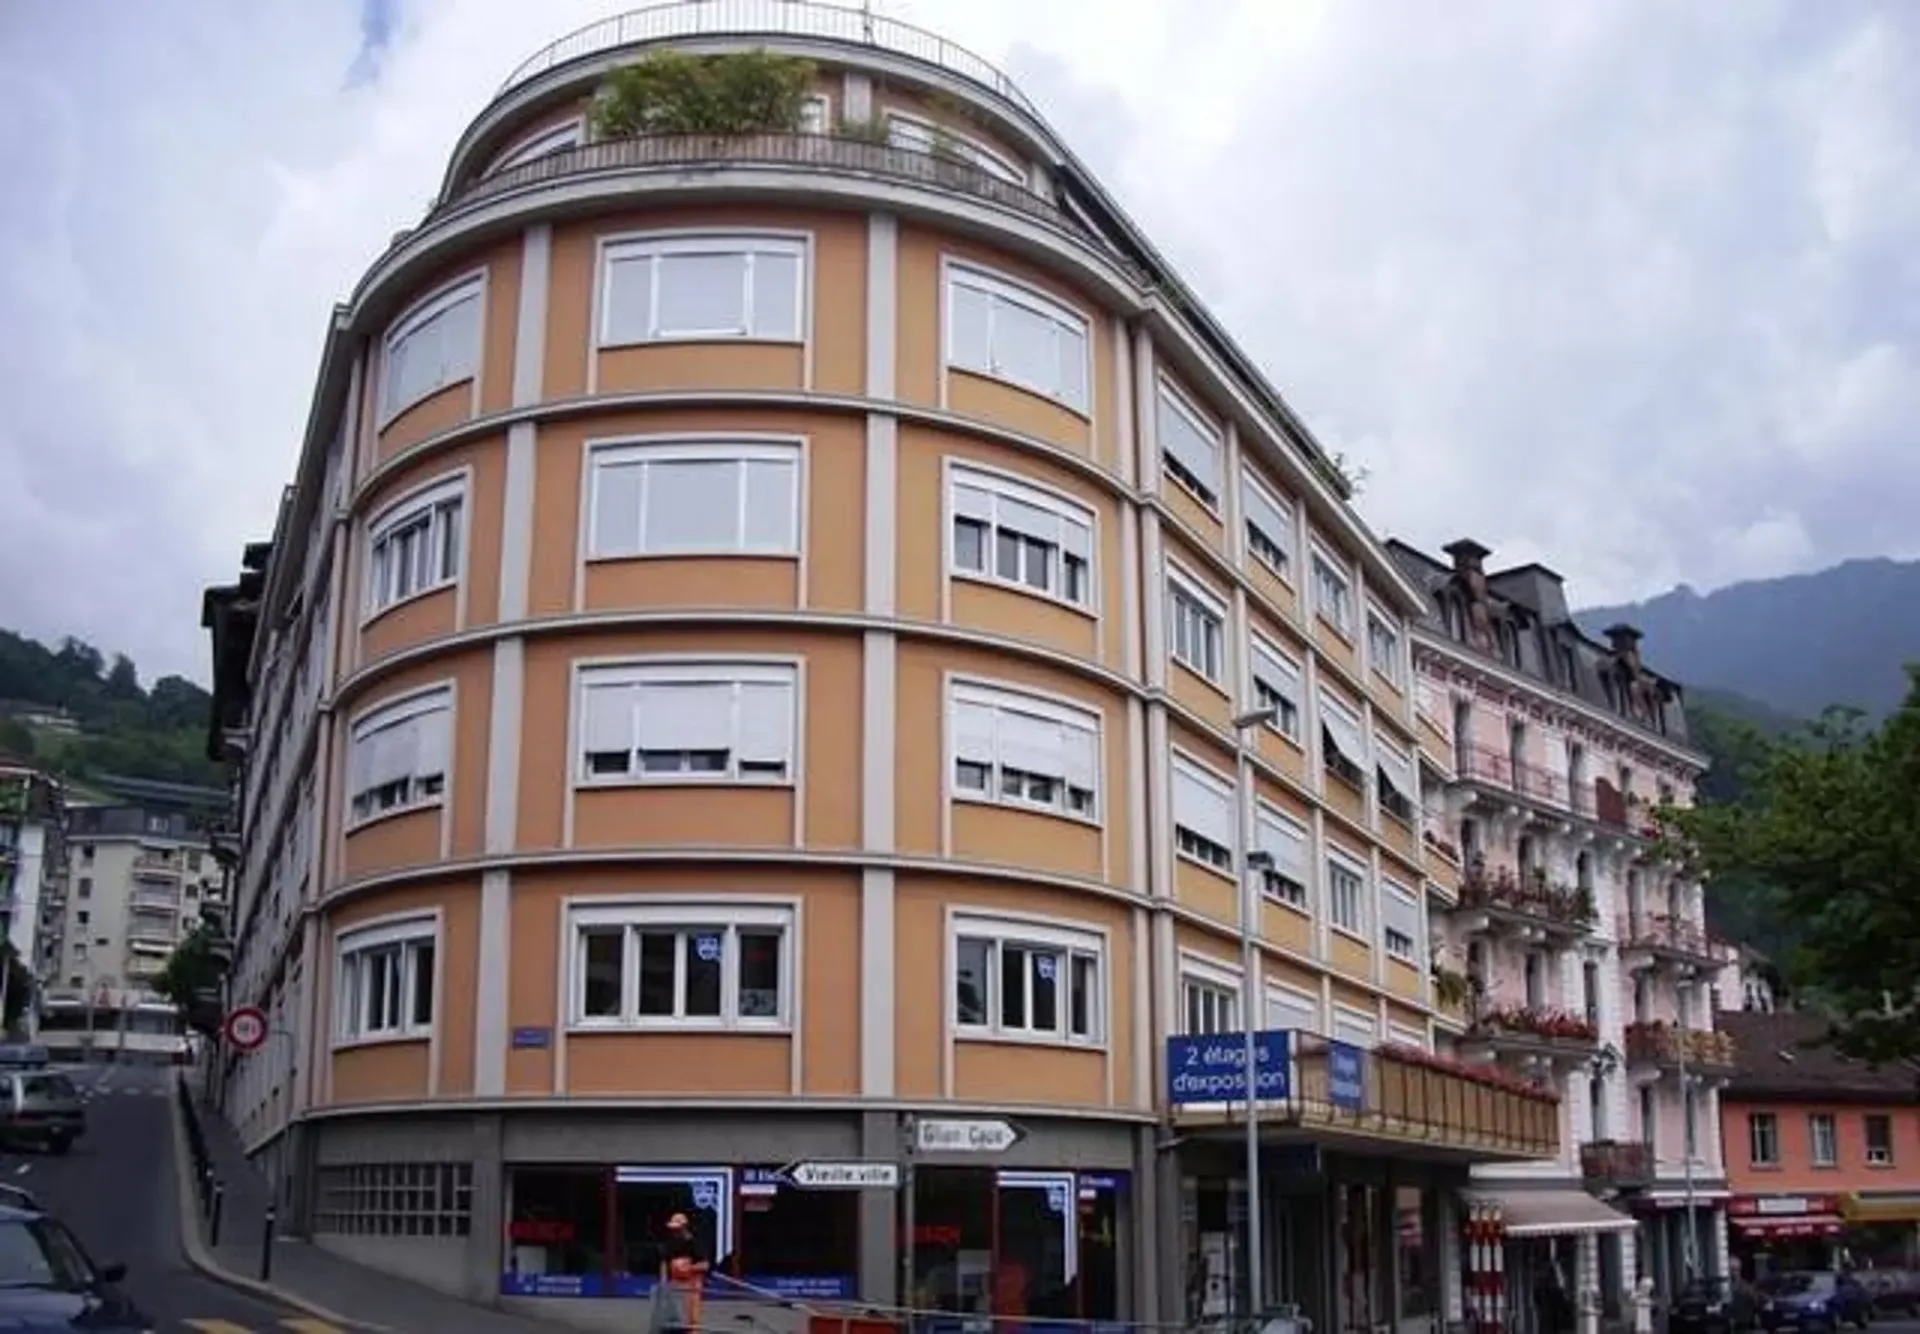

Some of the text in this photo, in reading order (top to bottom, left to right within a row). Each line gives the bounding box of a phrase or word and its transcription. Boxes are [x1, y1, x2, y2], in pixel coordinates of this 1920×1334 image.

[1186, 1045, 1270, 1069] 2 étags
[1173, 1072, 1285, 1096] d'exposion
[806, 1161, 853, 1181] Vieille
[859, 1164, 892, 1182] ville
